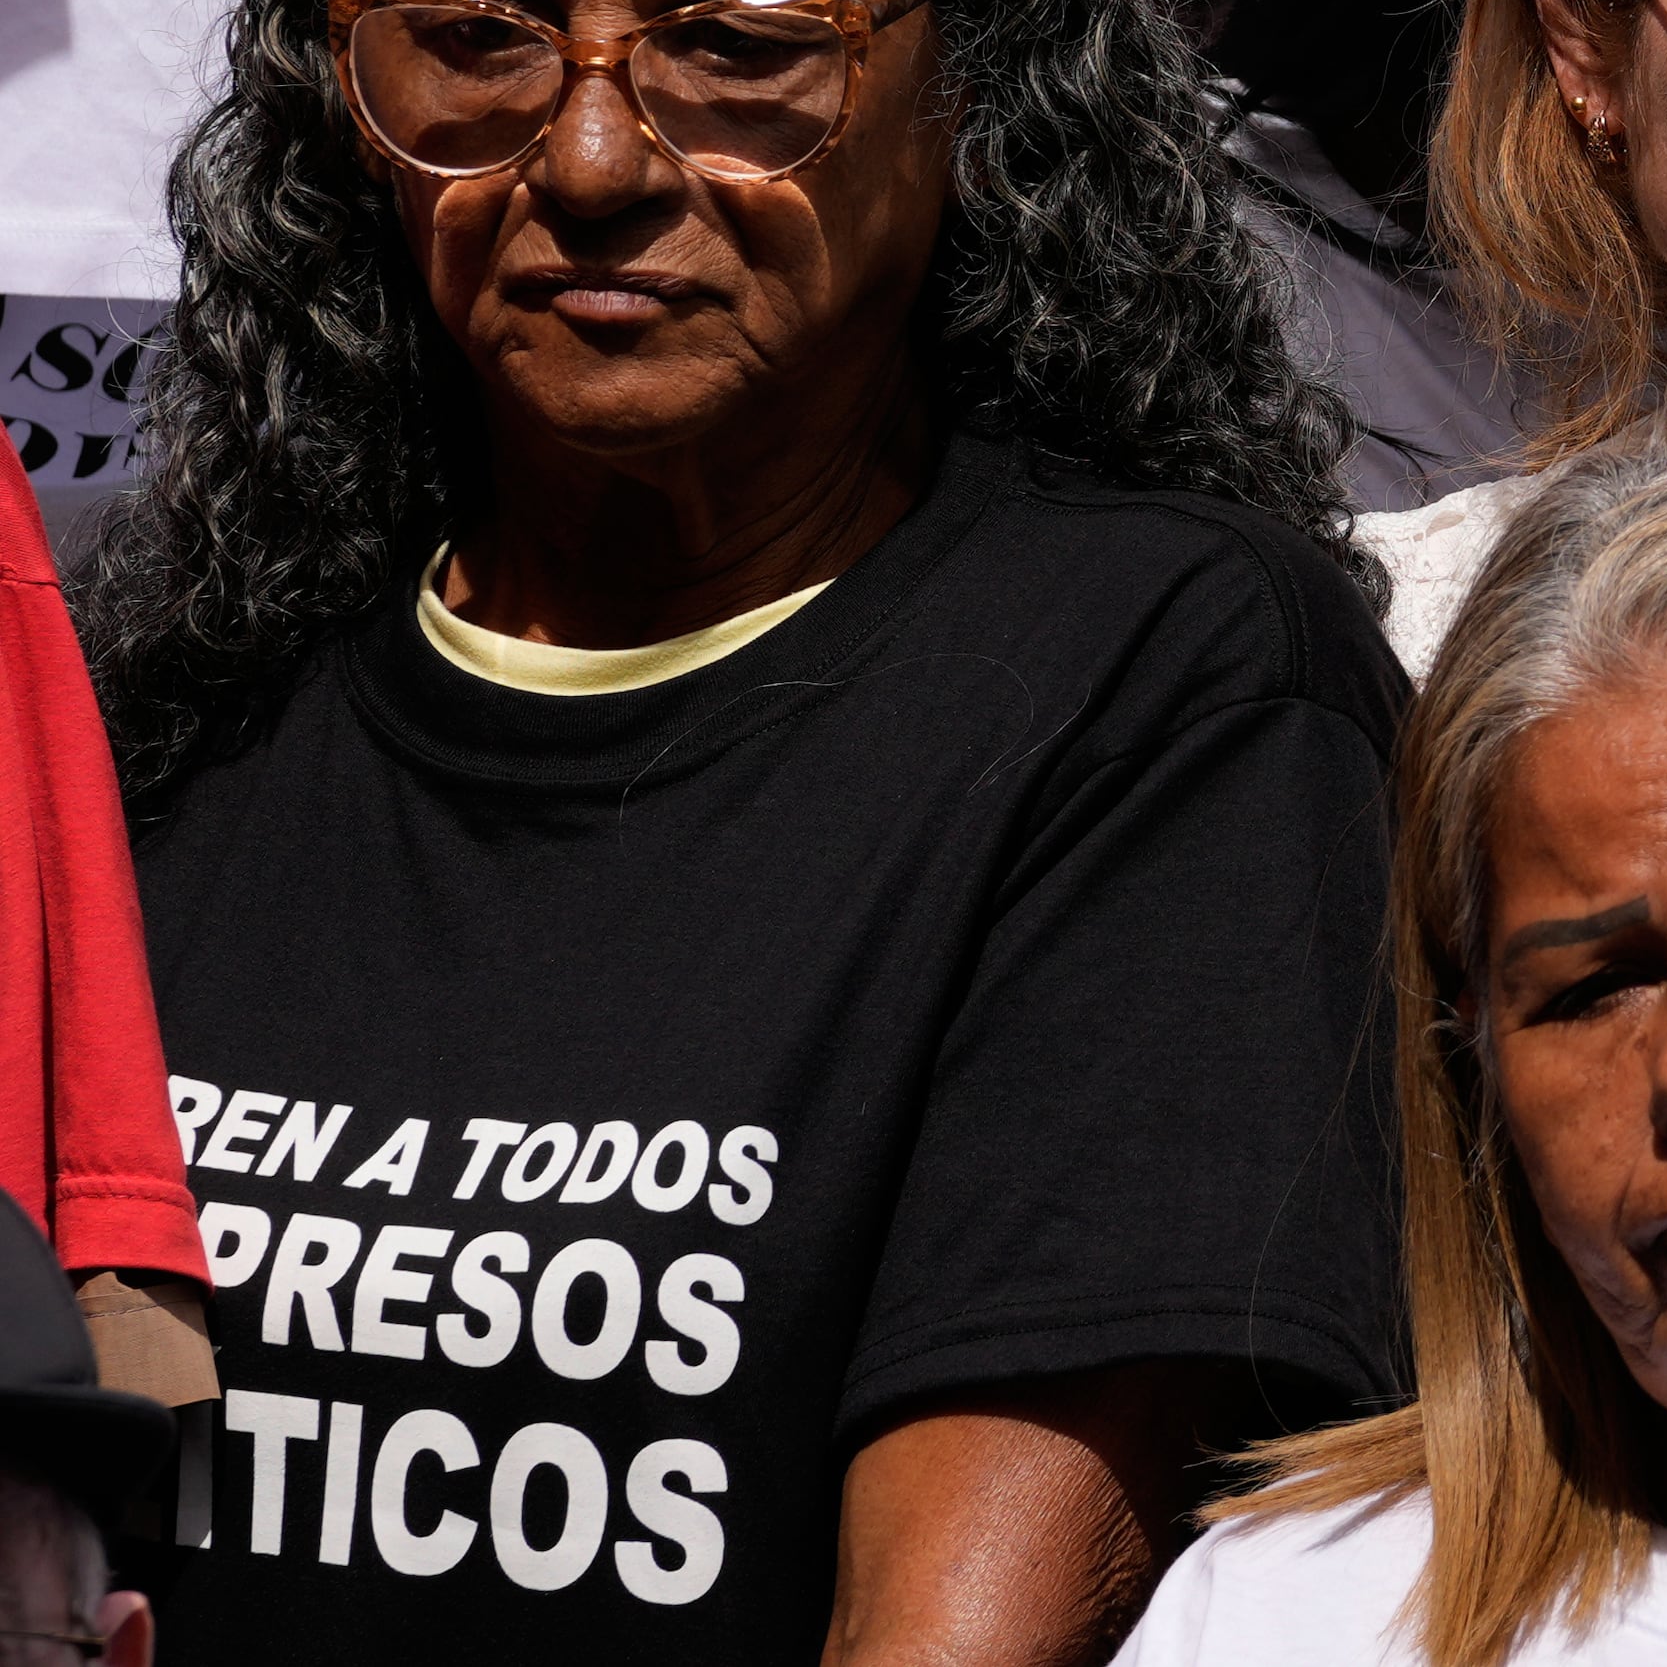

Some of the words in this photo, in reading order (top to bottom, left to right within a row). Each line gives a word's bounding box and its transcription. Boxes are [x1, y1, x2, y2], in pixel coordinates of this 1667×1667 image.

[343, 1118, 431, 1197] A
[452, 1117, 779, 1227] TODOS
[197, 1200, 746, 1397] PRESOS
[176, 1387, 730, 1607] TICOS
